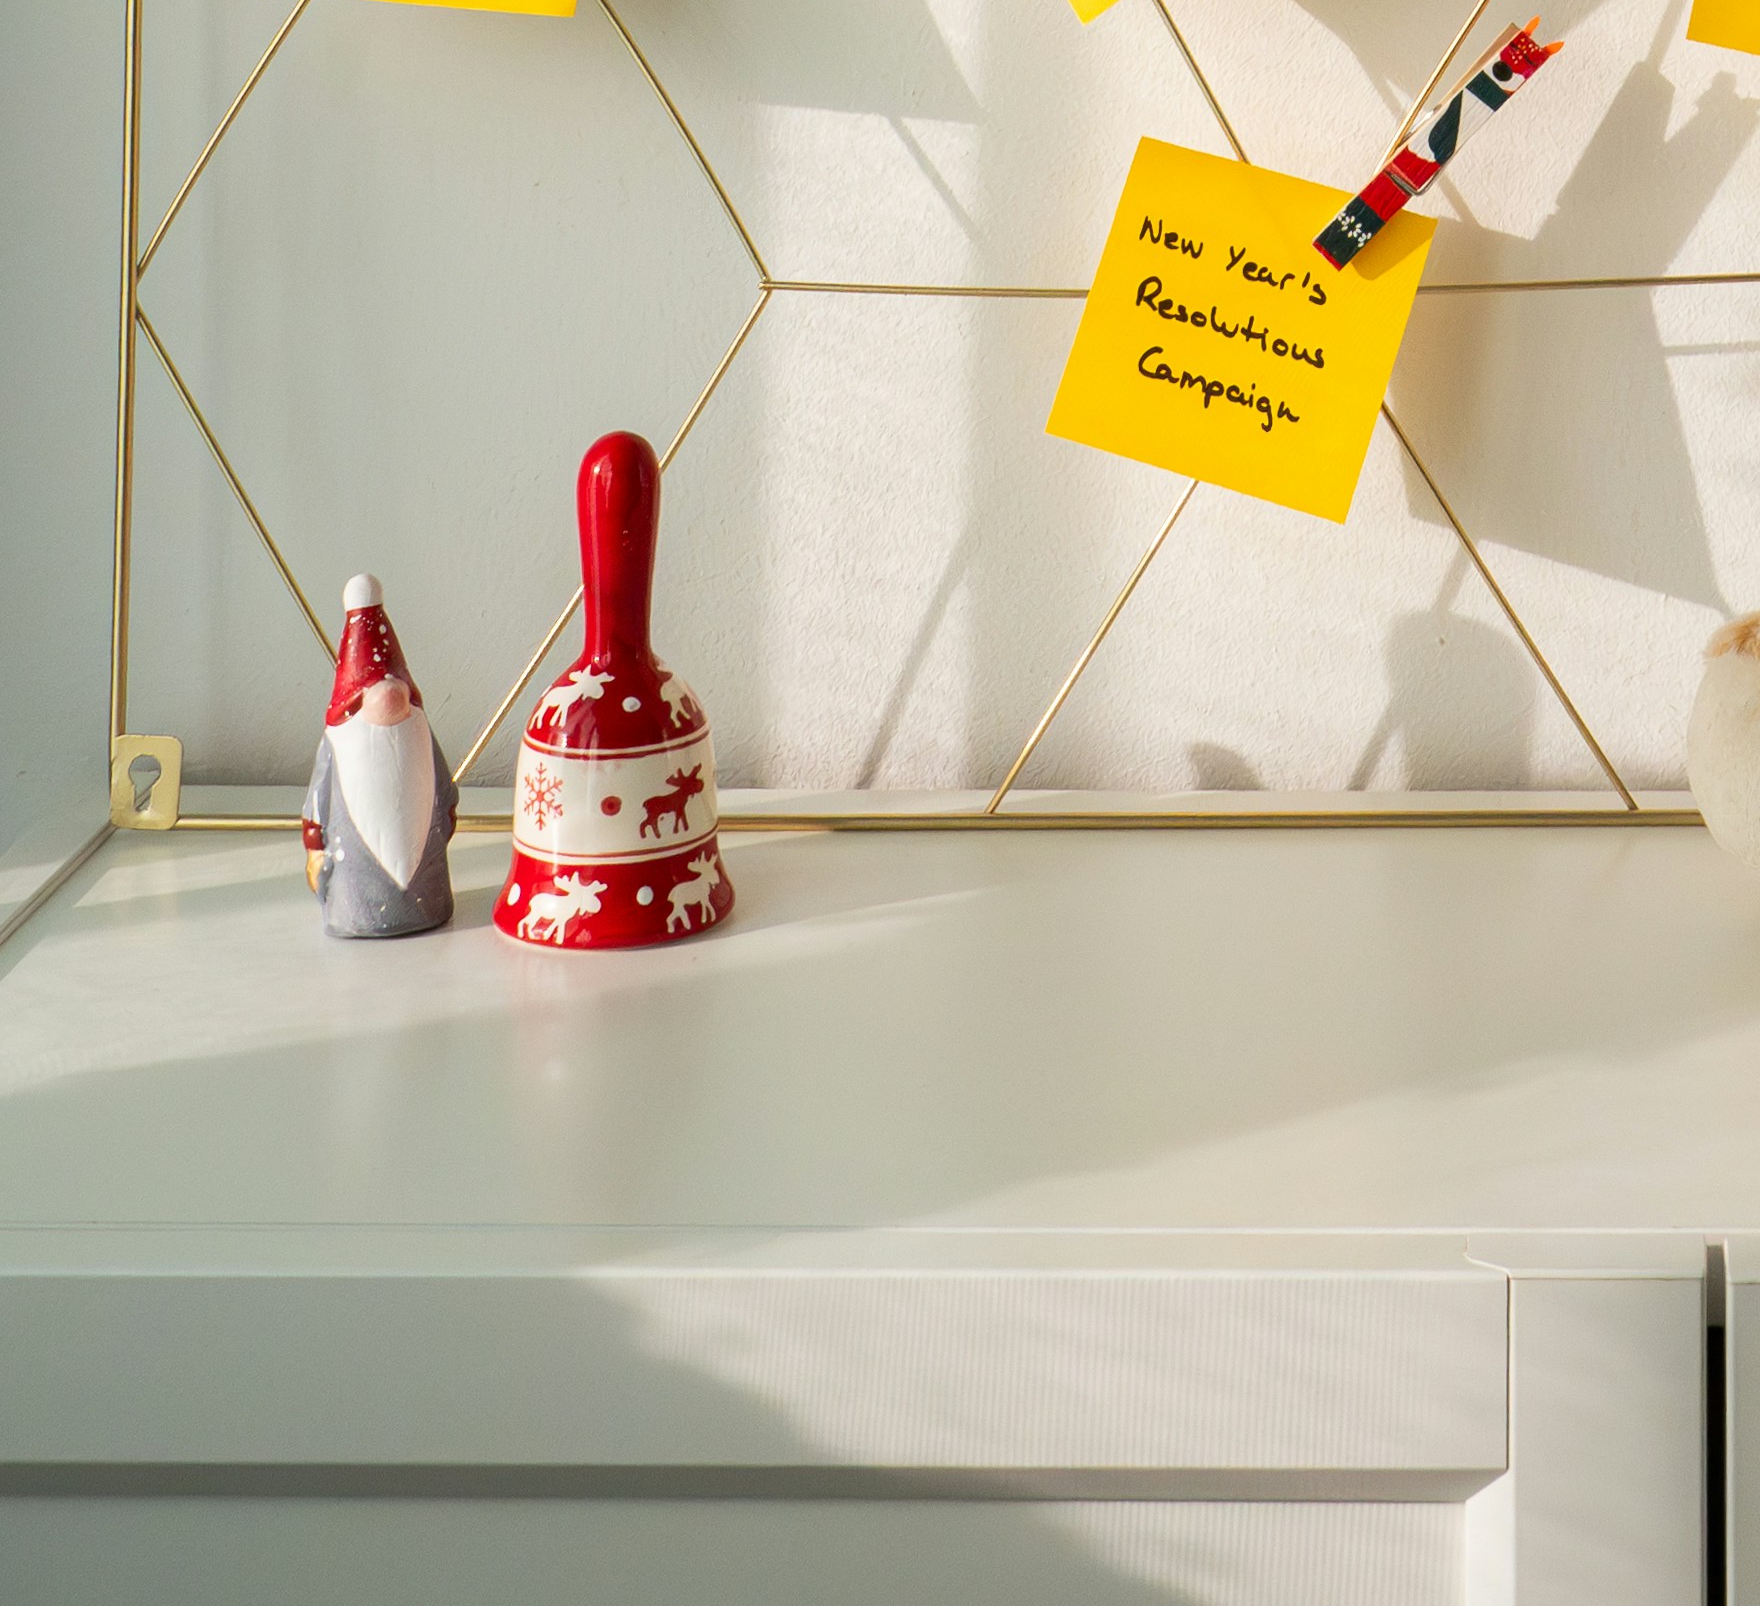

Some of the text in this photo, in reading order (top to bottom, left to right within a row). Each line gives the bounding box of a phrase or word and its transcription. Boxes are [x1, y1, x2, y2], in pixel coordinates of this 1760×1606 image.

[1139, 216, 1327, 305] New Year's
[1136, 276, 1325, 369] Resolutions
[1138, 346, 1300, 432] Campaign
